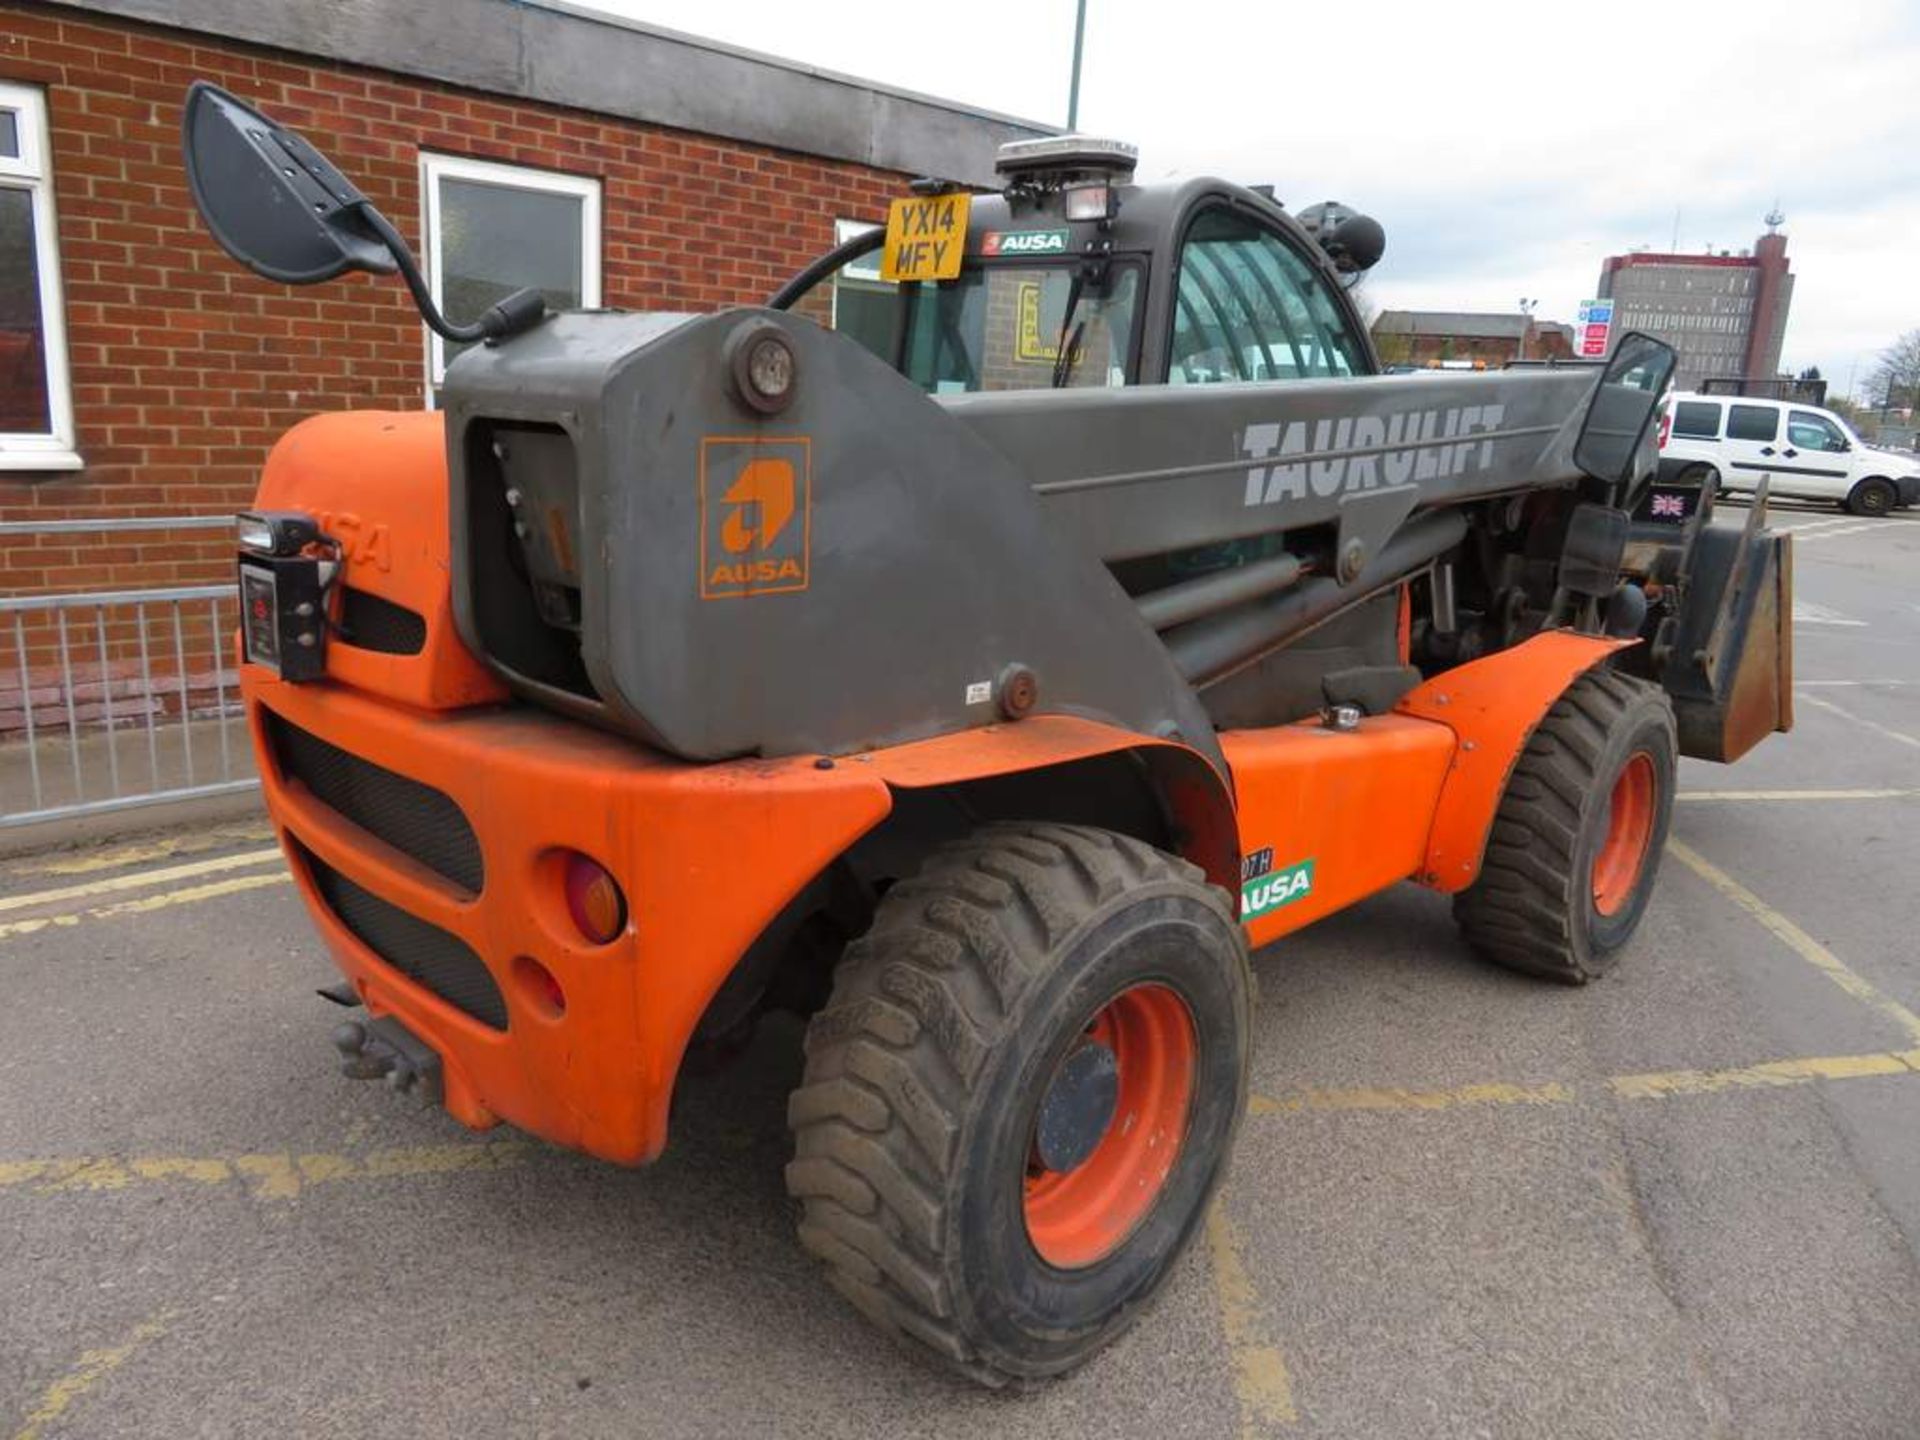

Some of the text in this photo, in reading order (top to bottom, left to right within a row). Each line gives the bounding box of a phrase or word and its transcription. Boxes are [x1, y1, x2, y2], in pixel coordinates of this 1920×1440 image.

[901, 201, 955, 237] YX14
[895, 240, 949, 274] MFY
[1002, 234, 1063, 250] AUSA
[1241, 404, 1505, 507] TAURULIFT
[709, 555, 803, 585] AUSA
